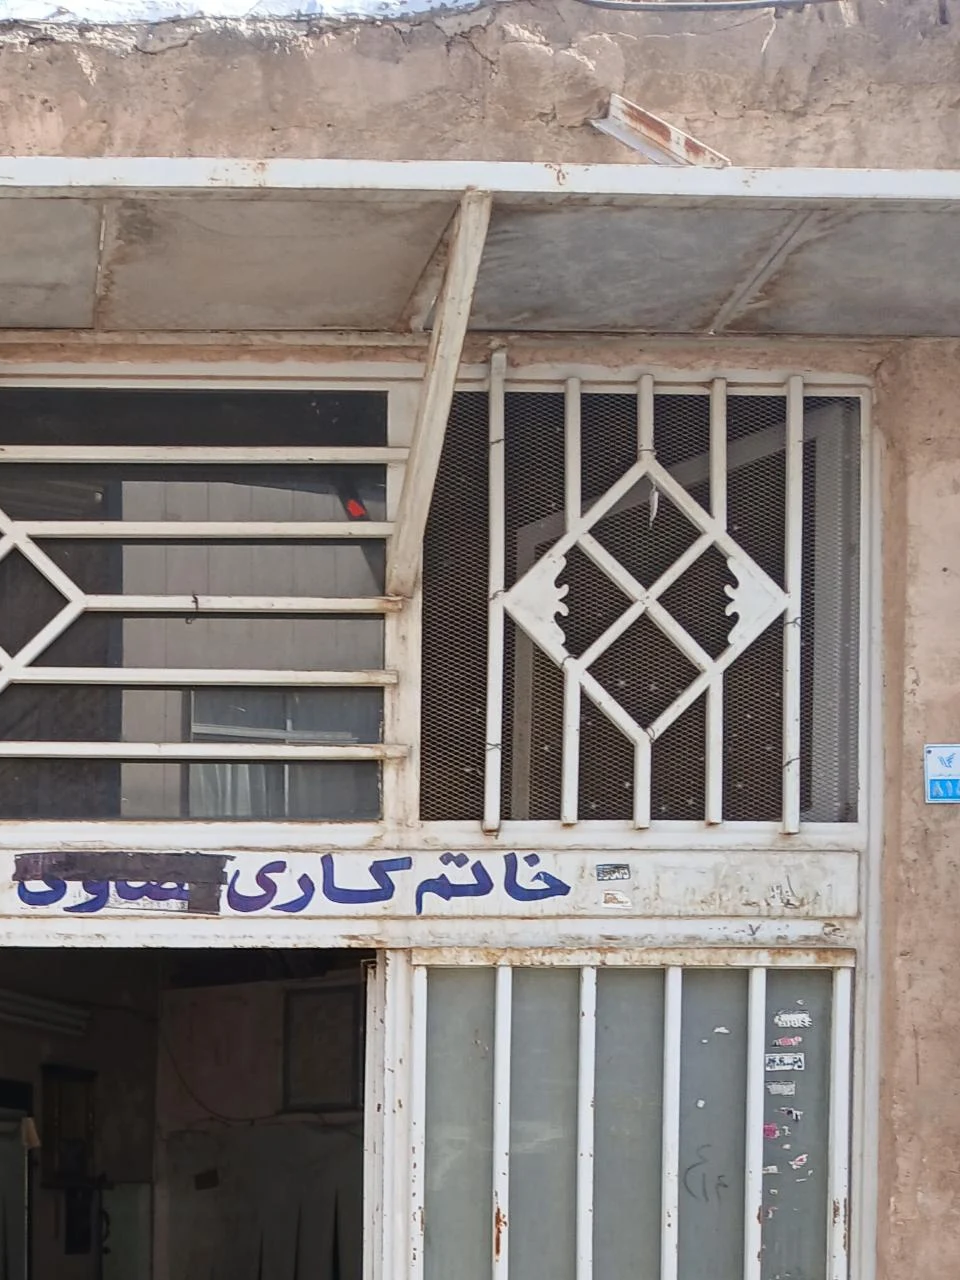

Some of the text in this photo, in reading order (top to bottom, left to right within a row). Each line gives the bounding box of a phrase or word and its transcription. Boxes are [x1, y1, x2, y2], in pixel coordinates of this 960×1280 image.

[932, 780, 960, 798] ۸۱
[227, 853, 413, 913] کاری
[416, 852, 572, 915] خاتم
